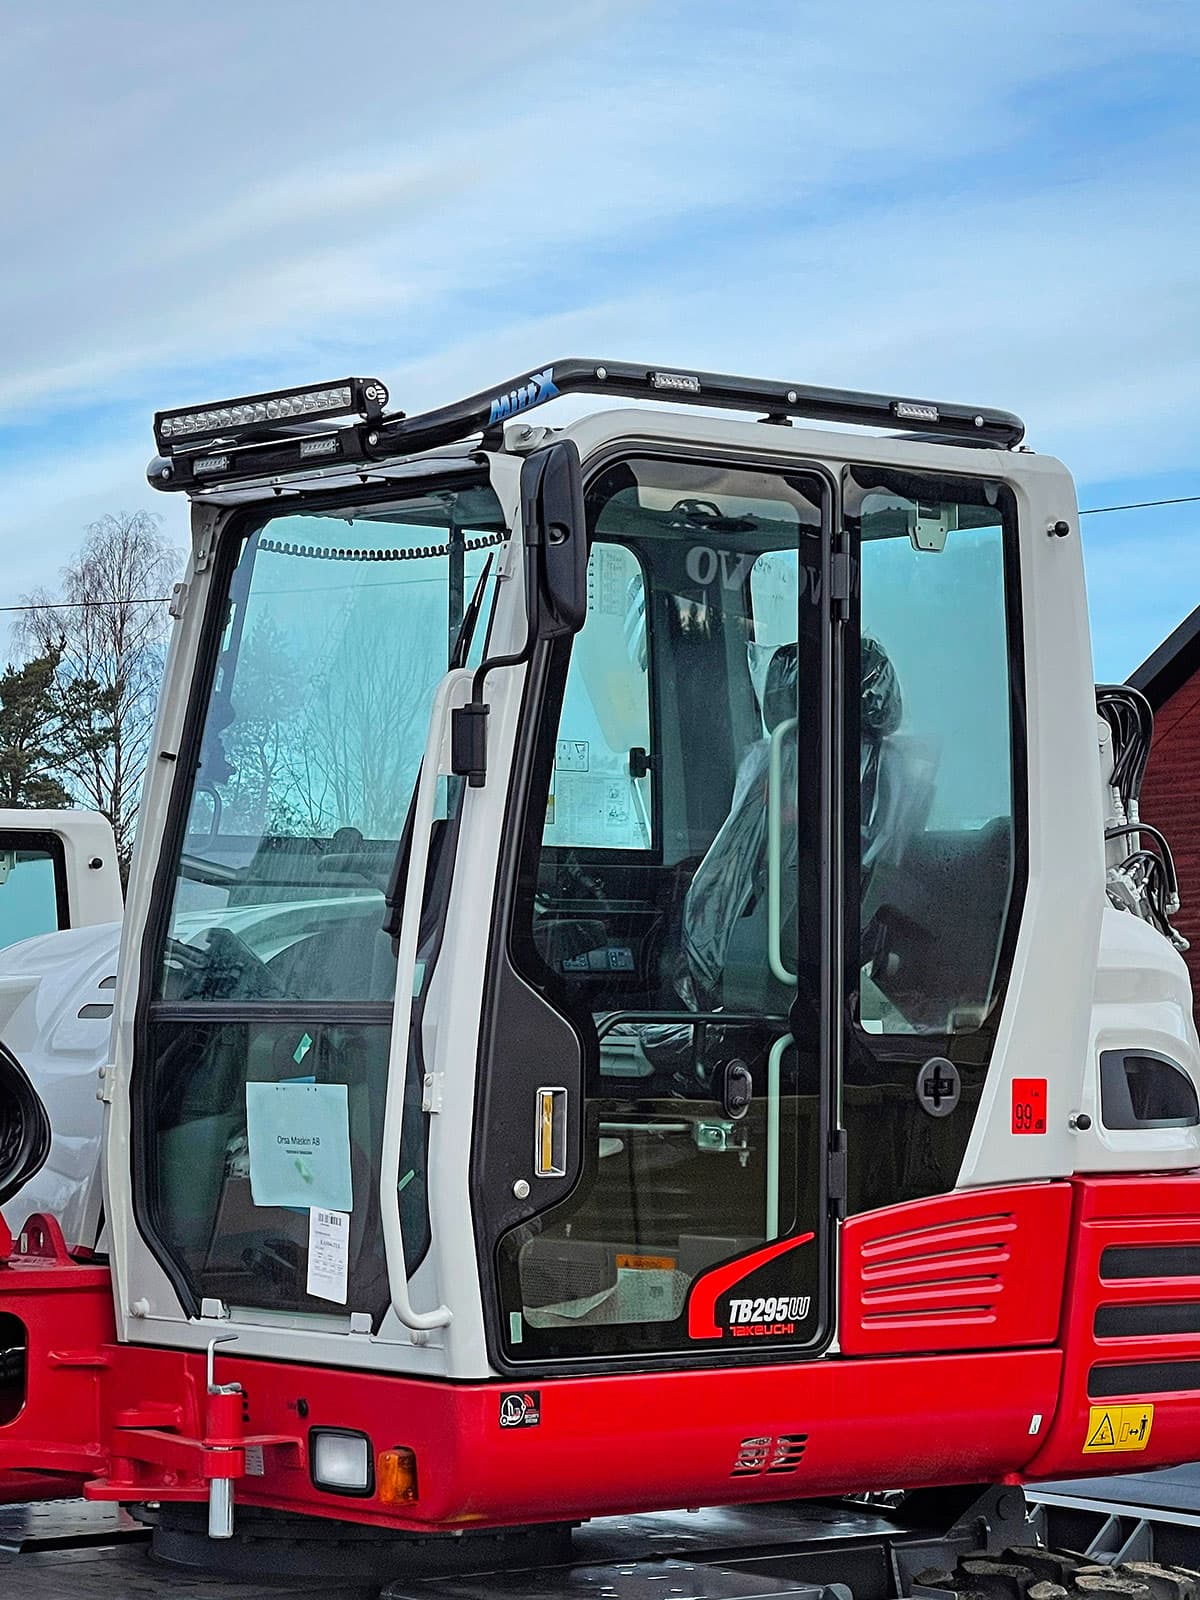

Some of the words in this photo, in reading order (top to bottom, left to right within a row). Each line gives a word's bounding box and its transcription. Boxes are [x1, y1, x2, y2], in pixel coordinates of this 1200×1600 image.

[489, 367, 560, 425] MittX
[1016, 1104, 1032, 1130] 99
[276, 1135, 290, 1145] Orsa
[291, 1136, 311, 1146] Maskin
[312, 1137, 321, 1146] AB
[729, 1296, 811, 1323] TB295W
